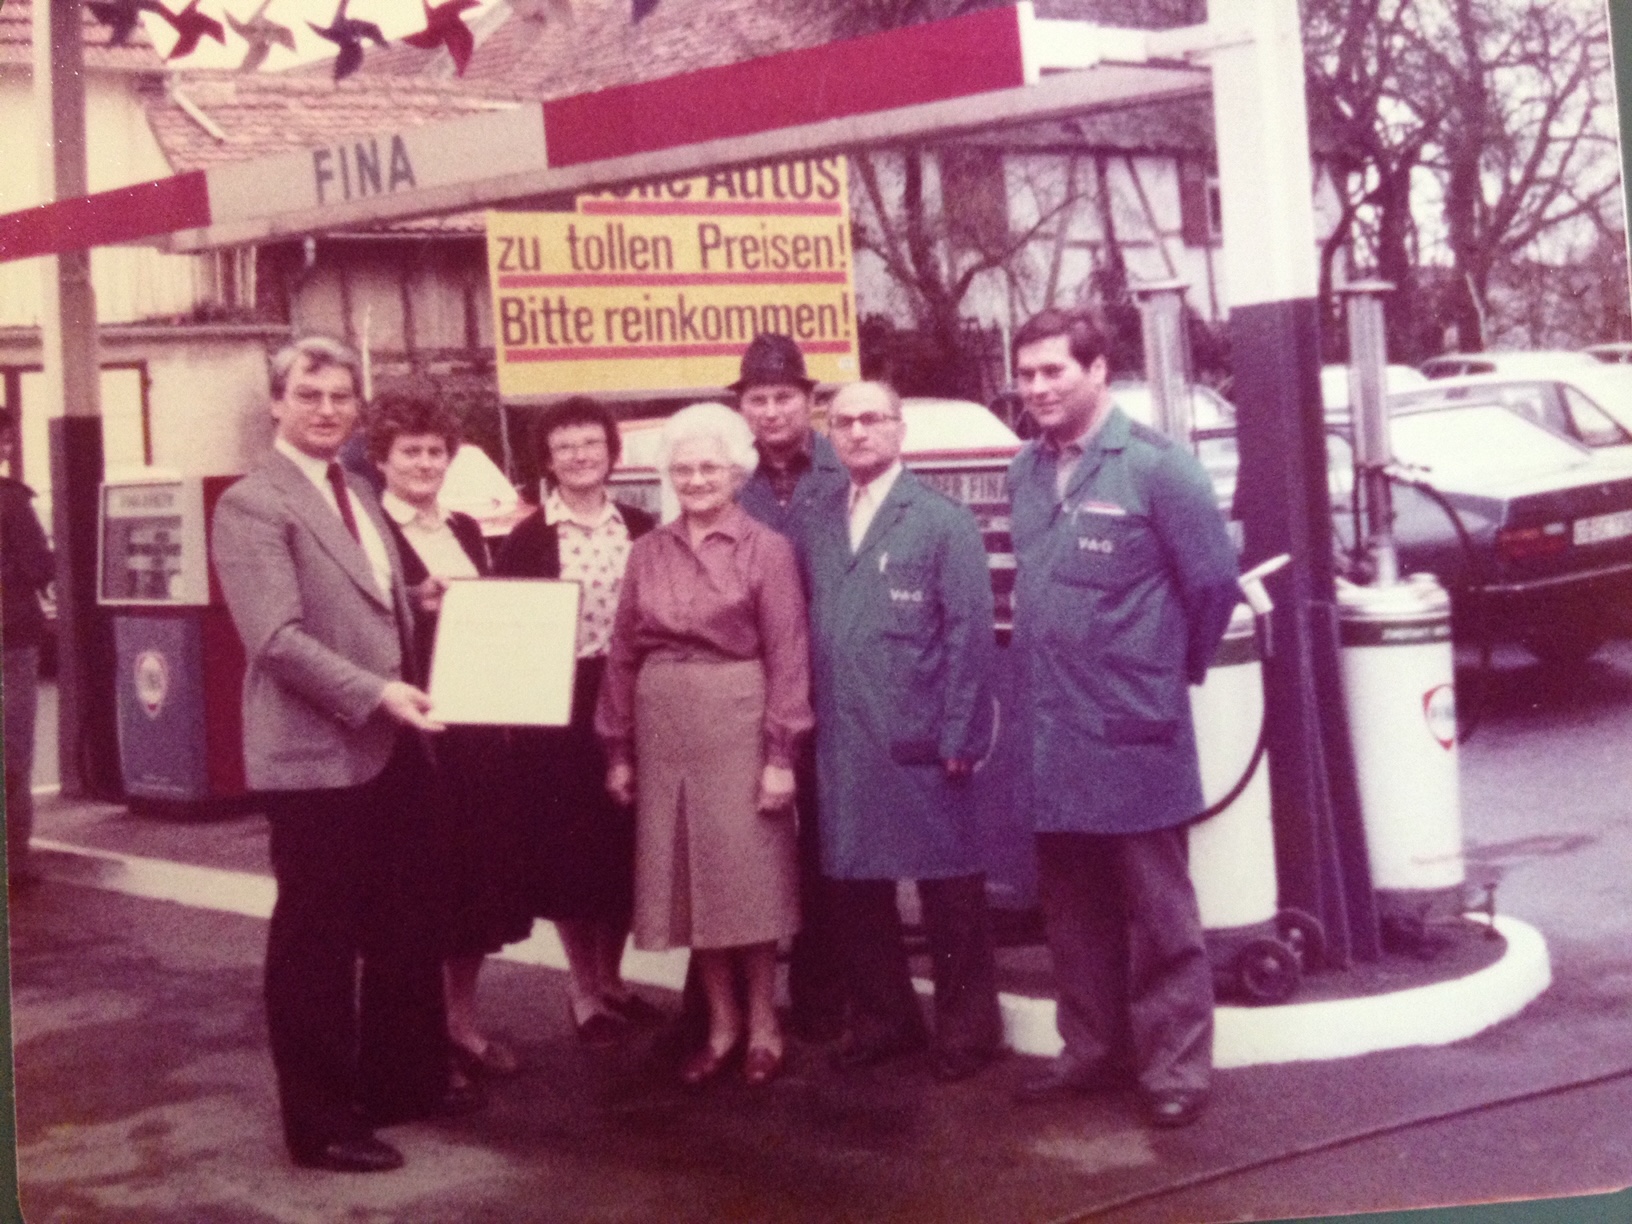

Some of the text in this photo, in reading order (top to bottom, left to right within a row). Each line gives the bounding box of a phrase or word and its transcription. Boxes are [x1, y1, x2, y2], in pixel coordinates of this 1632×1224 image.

[313, 134, 417, 205] FINA
[497, 222, 847, 272] zu tollen Preisen!
[501, 292, 851, 346] Bitte reinkommen!
